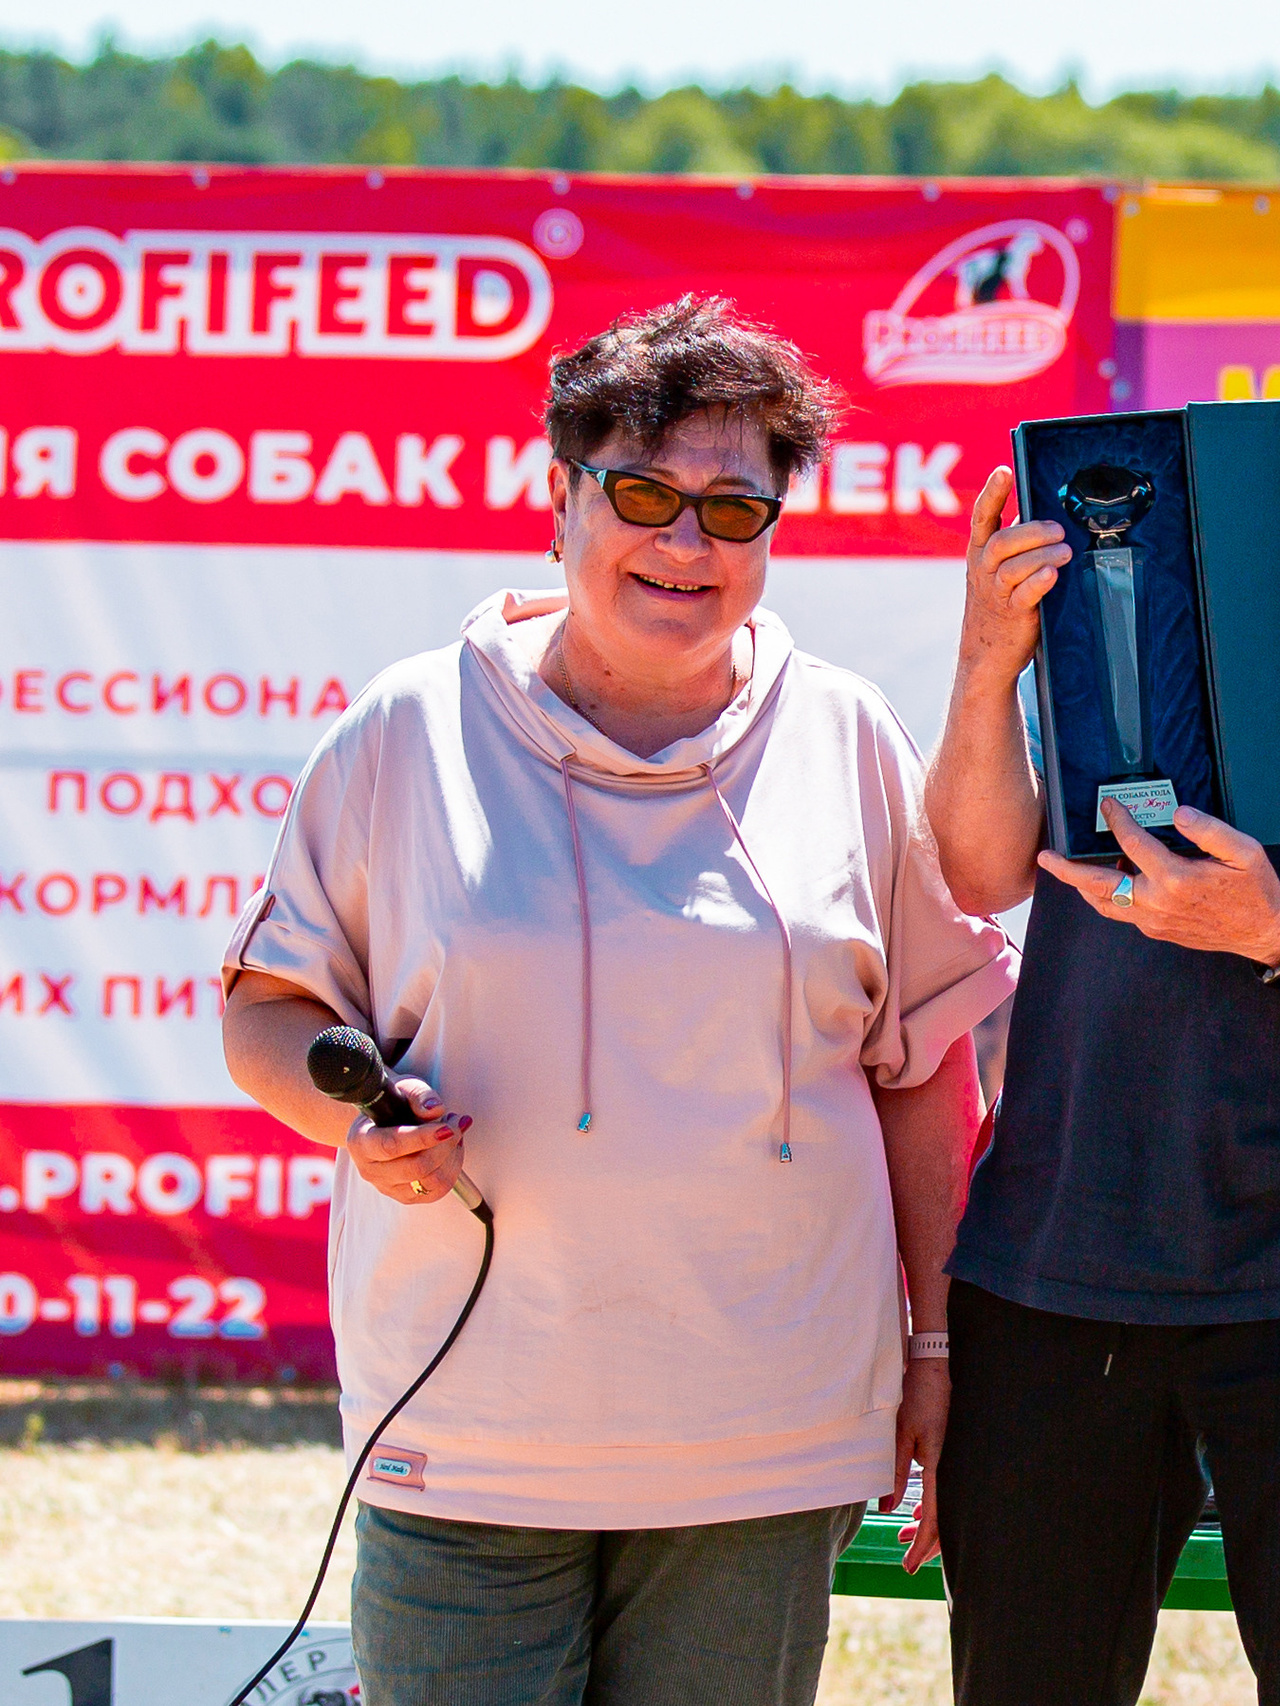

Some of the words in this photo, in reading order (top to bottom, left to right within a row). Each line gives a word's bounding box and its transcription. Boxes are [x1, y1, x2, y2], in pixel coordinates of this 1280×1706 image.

[0, 427, 78, 499] Я
[100, 428, 463, 509] СОБАК
[0, 670, 351, 717] ЕССИОНА
[0, 872, 266, 918] КОРМЛ
